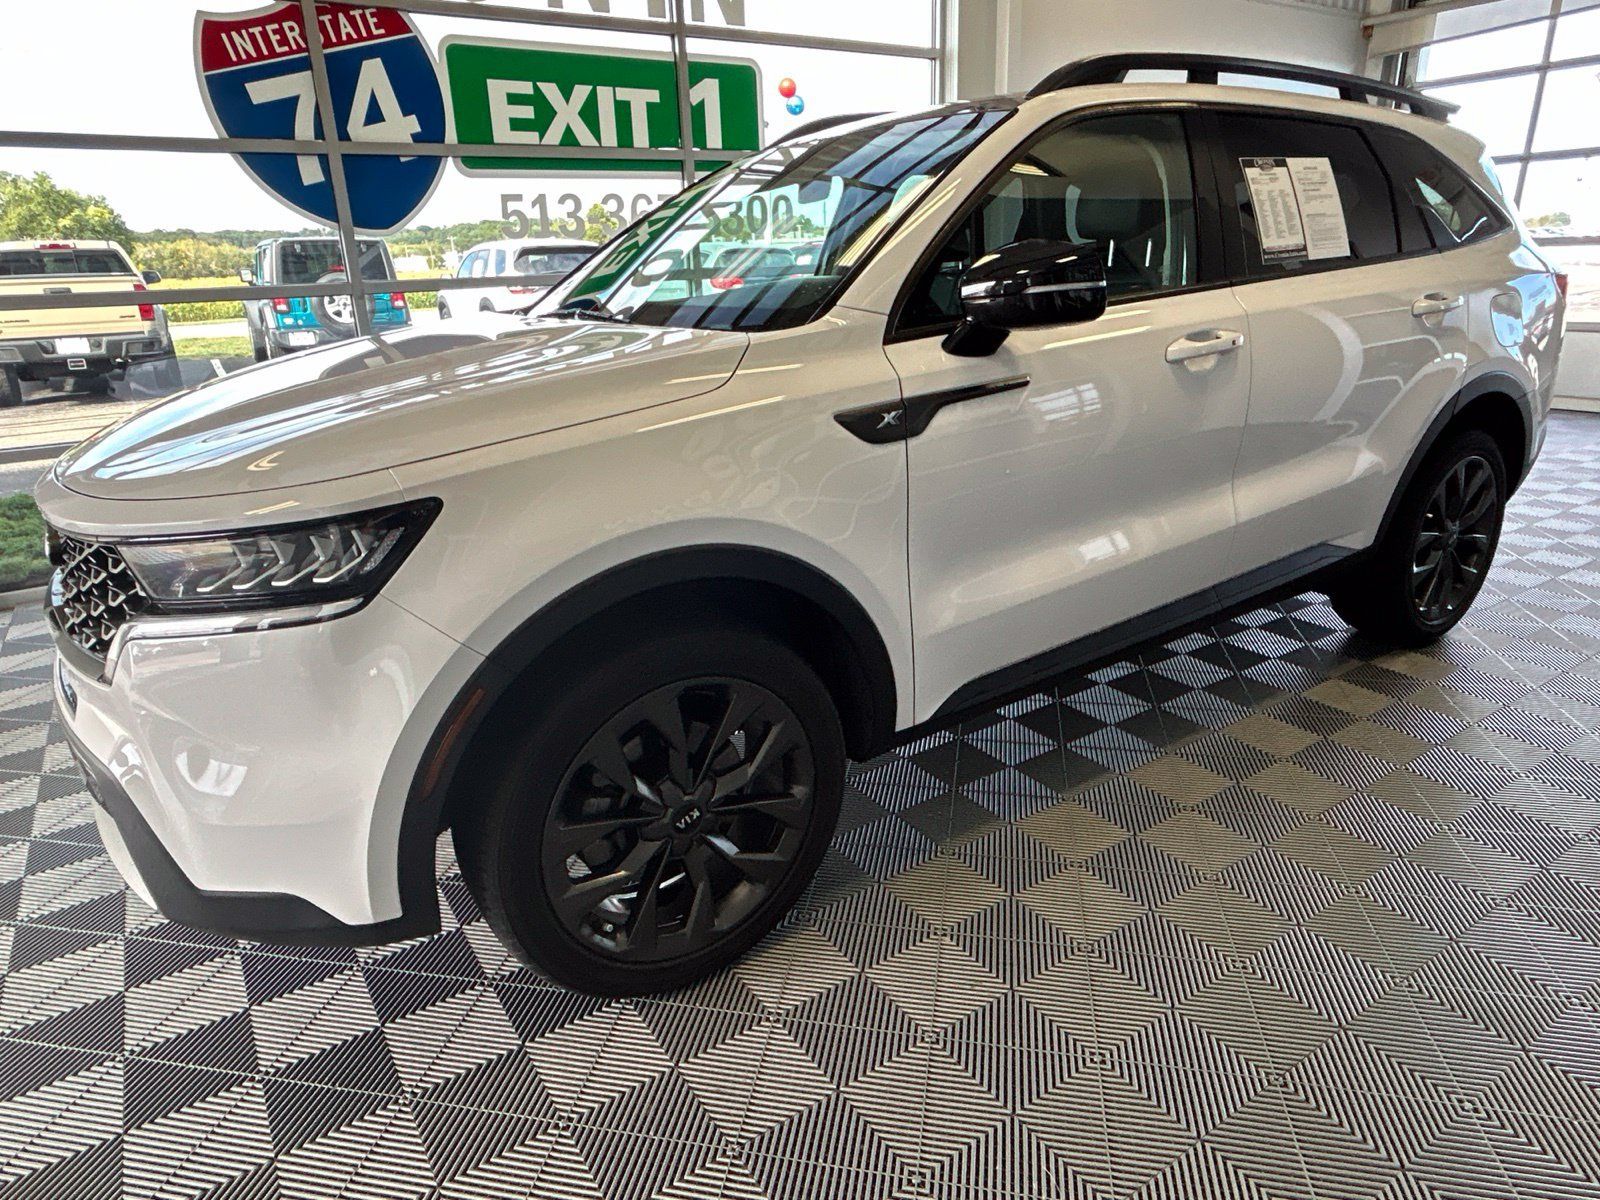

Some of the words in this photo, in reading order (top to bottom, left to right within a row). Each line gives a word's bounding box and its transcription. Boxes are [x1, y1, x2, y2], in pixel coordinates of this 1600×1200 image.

[220, 8, 386, 62] INTERTATE
[244, 57, 422, 186] 74
[486, 78, 660, 149] EXIT
[688, 78, 723, 150] 1
[675, 808, 701, 829] KIA
